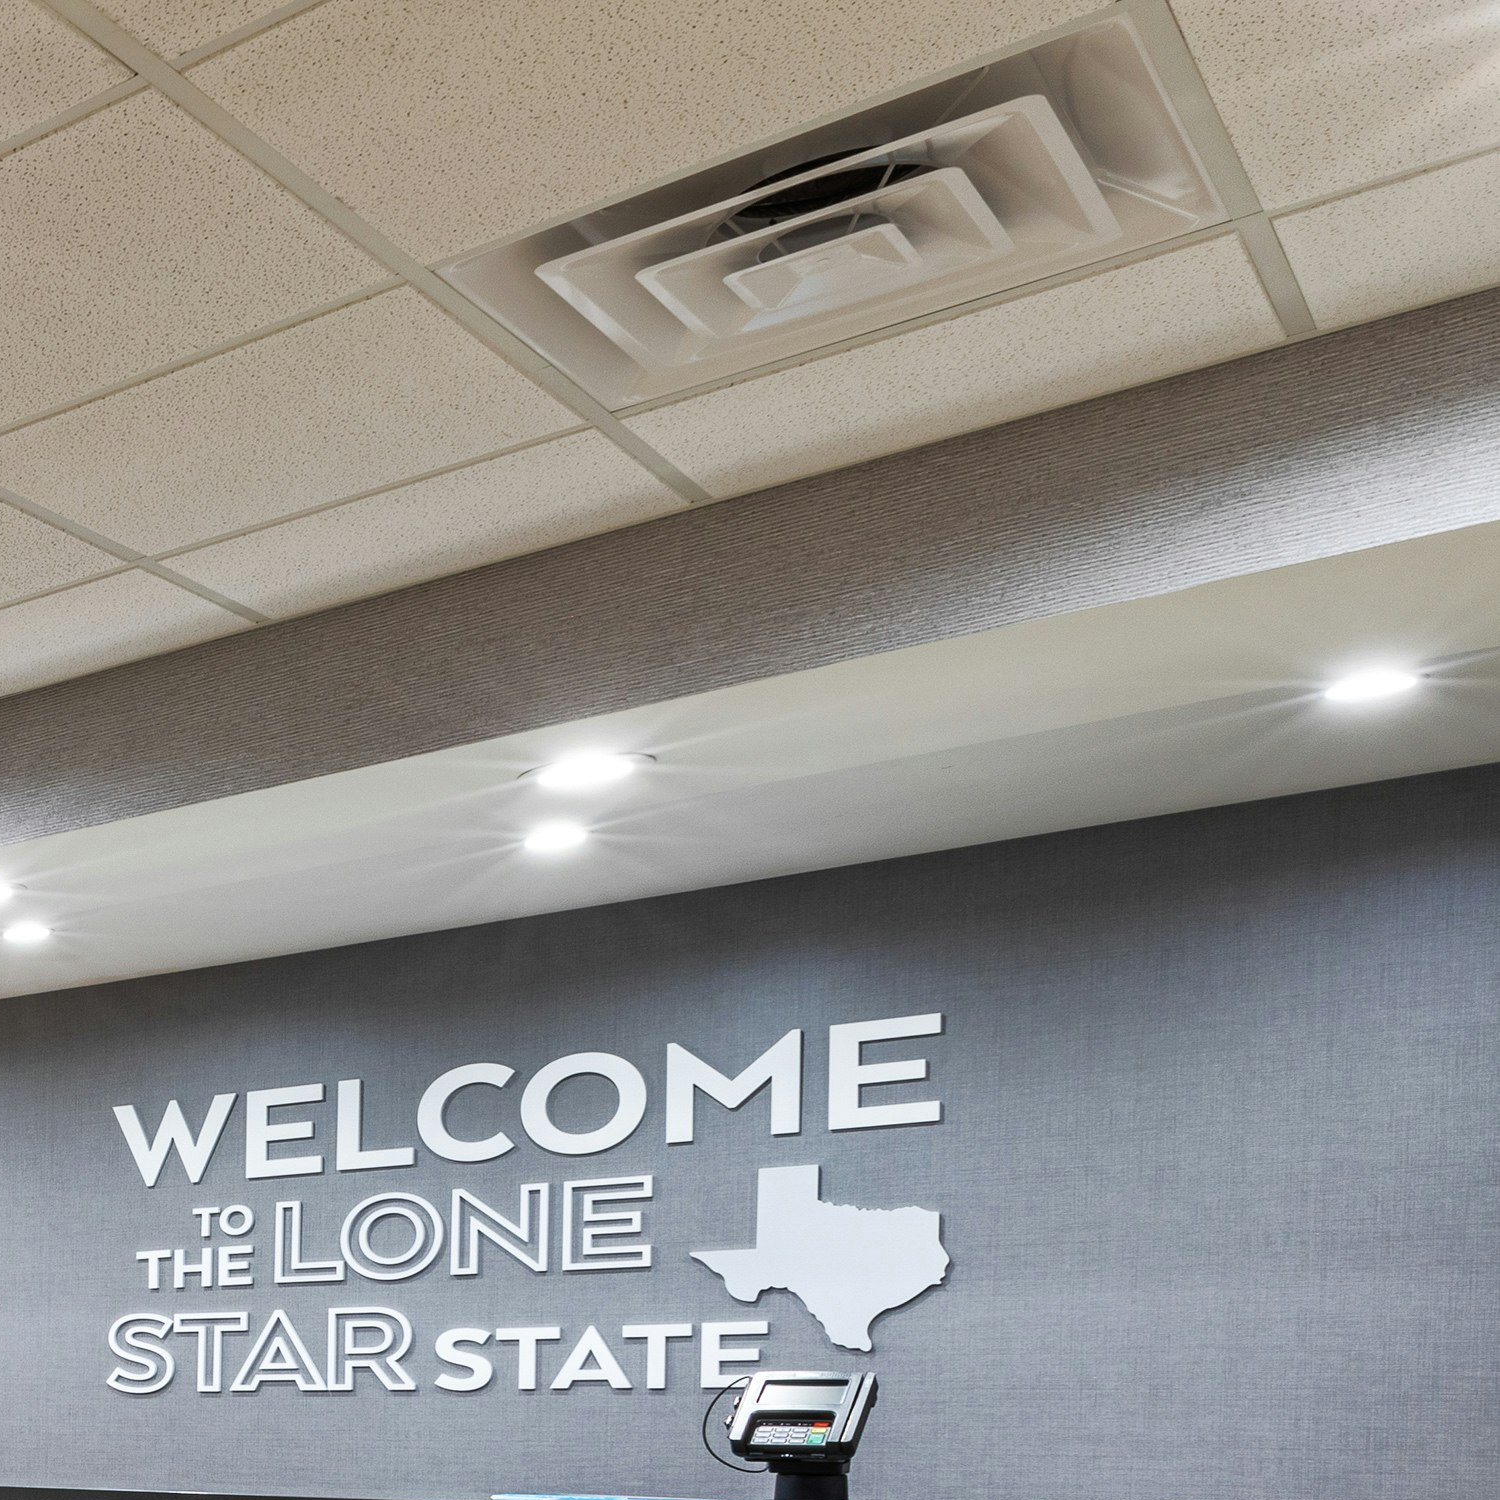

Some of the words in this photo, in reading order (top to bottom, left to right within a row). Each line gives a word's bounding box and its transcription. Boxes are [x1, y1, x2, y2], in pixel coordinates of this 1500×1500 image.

[112, 1012, 943, 1187] WELCOME
[192, 1204, 254, 1239] TO
[272, 1174, 654, 1286] LONE
[136, 1245, 255, 1289] THE
[106, 1306, 417, 1393] STAR
[433, 1320, 770, 1391] STATE
